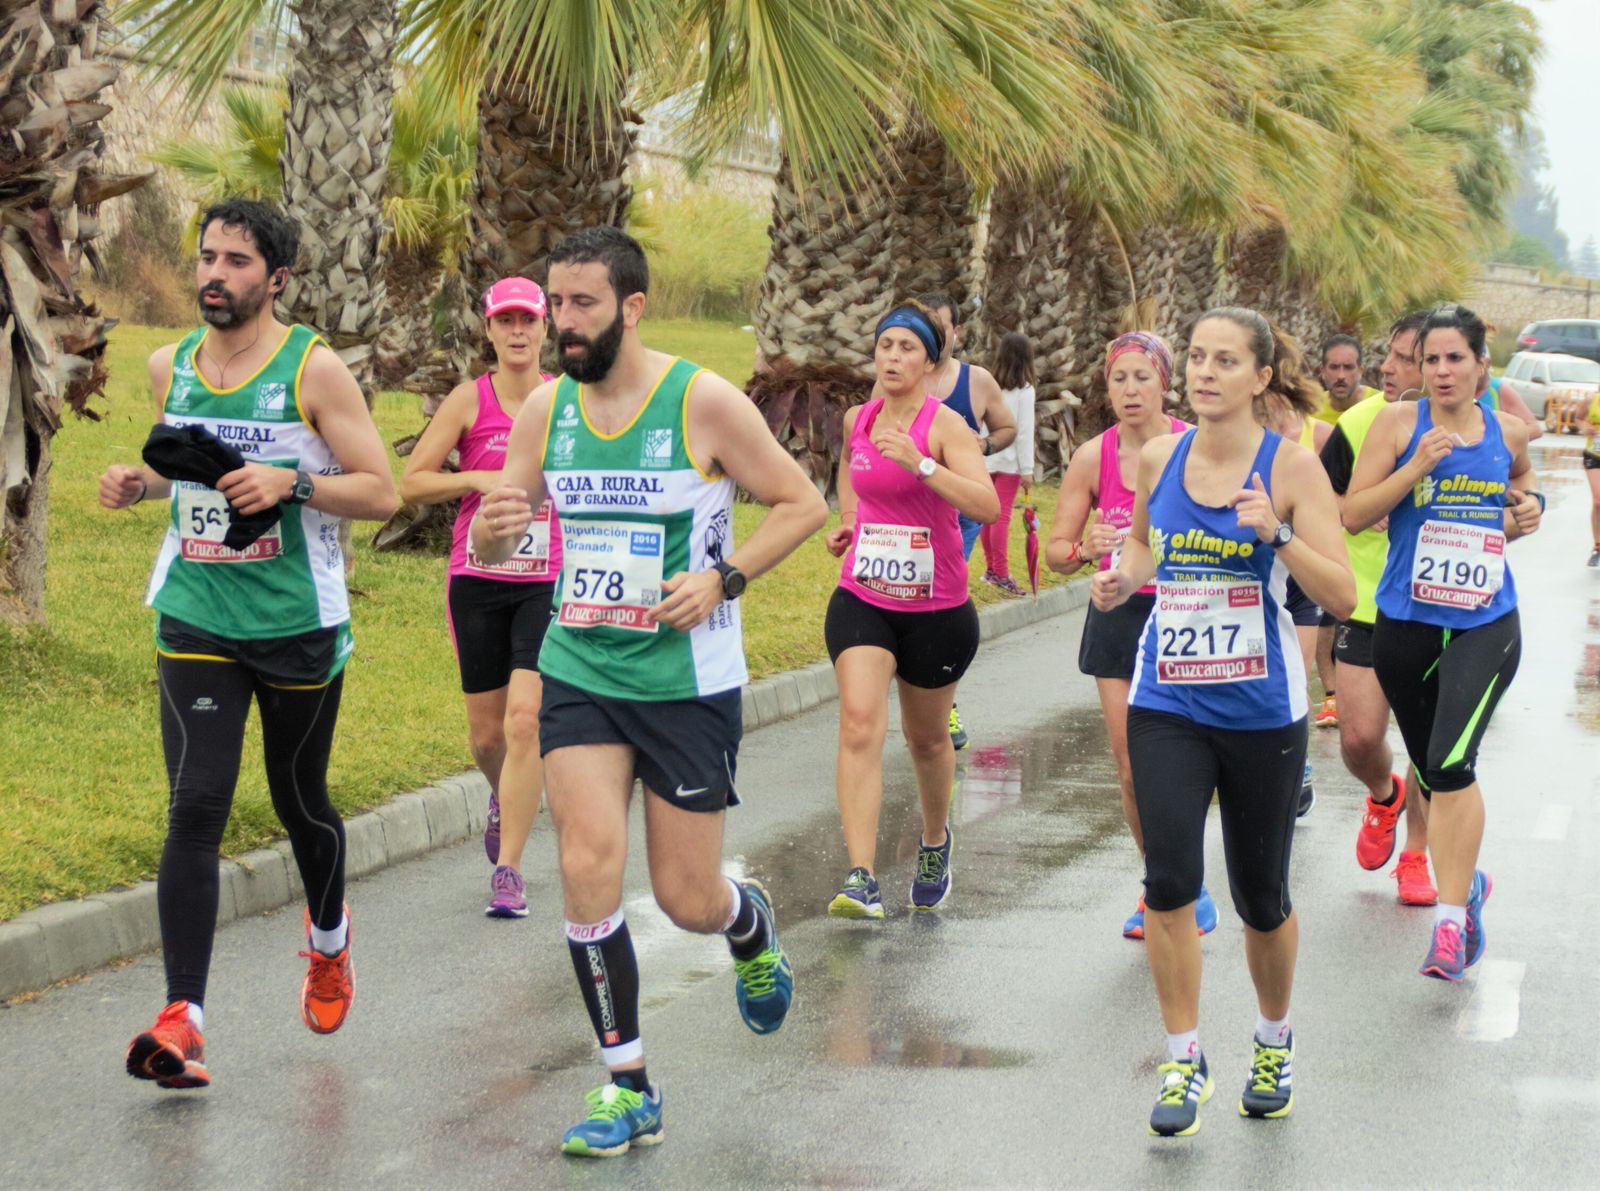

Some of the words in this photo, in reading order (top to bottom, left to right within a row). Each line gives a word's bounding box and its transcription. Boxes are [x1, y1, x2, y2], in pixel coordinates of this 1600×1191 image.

[217, 424, 276, 442] RURAL
[556, 477, 594, 492] CAJA
[601, 476, 664, 493] RURAL
[565, 494, 581, 505] DE
[584, 494, 649, 506] GRANADA
[1436, 493, 1481, 503] deportes
[191, 506, 231, 535] 56
[1438, 510, 1459, 518] TRAIL
[633, 534, 657, 544] 2016
[1423, 523, 1483, 539] Diputación
[565, 538, 614, 552] Granada
[861, 537, 897, 547] Granada
[1170, 528, 1254, 558] olimpo
[1420, 535, 1469, 549] Granada
[1168, 551, 1221, 564] deportes
[857, 556, 917, 582] 2003
[1417, 556, 1488, 588] 2190
[572, 568, 625, 601] 578
[1173, 573, 1197, 582] TRAIL
[1200, 573, 1208, 582] &
[564, 603, 638, 624] Cruzcampo
[1160, 601, 1209, 611] Granada
[1162, 624, 1241, 657] 2217
[1165, 661, 1245, 679] Cruzcampo
